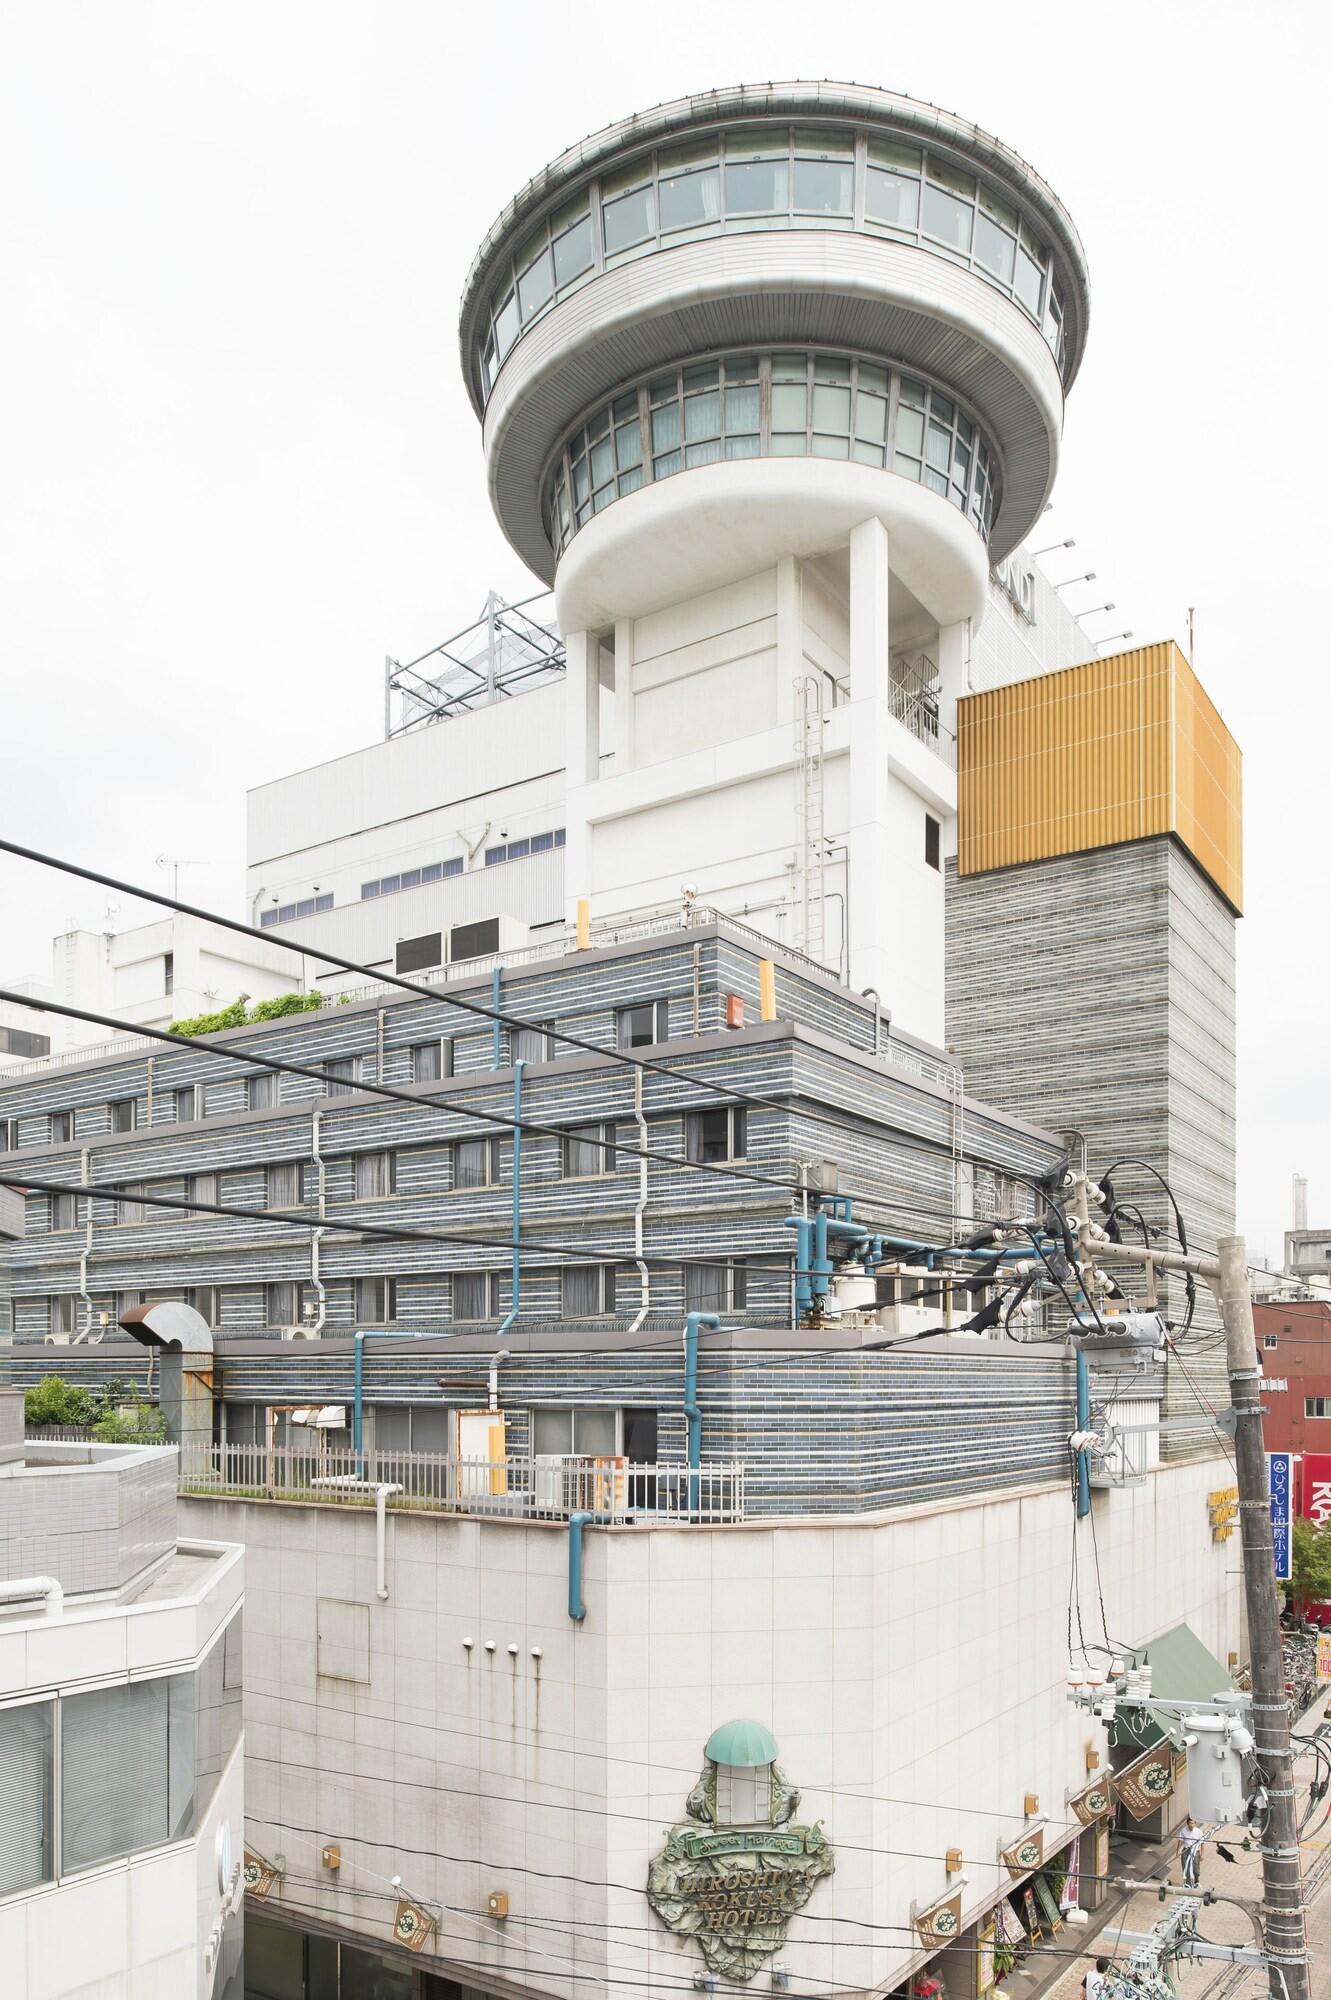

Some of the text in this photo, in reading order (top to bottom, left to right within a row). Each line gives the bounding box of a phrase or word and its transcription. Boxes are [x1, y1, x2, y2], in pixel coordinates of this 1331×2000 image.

[679, 1868, 813, 1893] HIROSHIMA
[693, 1887, 799, 1912] KOKUSAI
[705, 1908, 786, 1930] HOTEL
